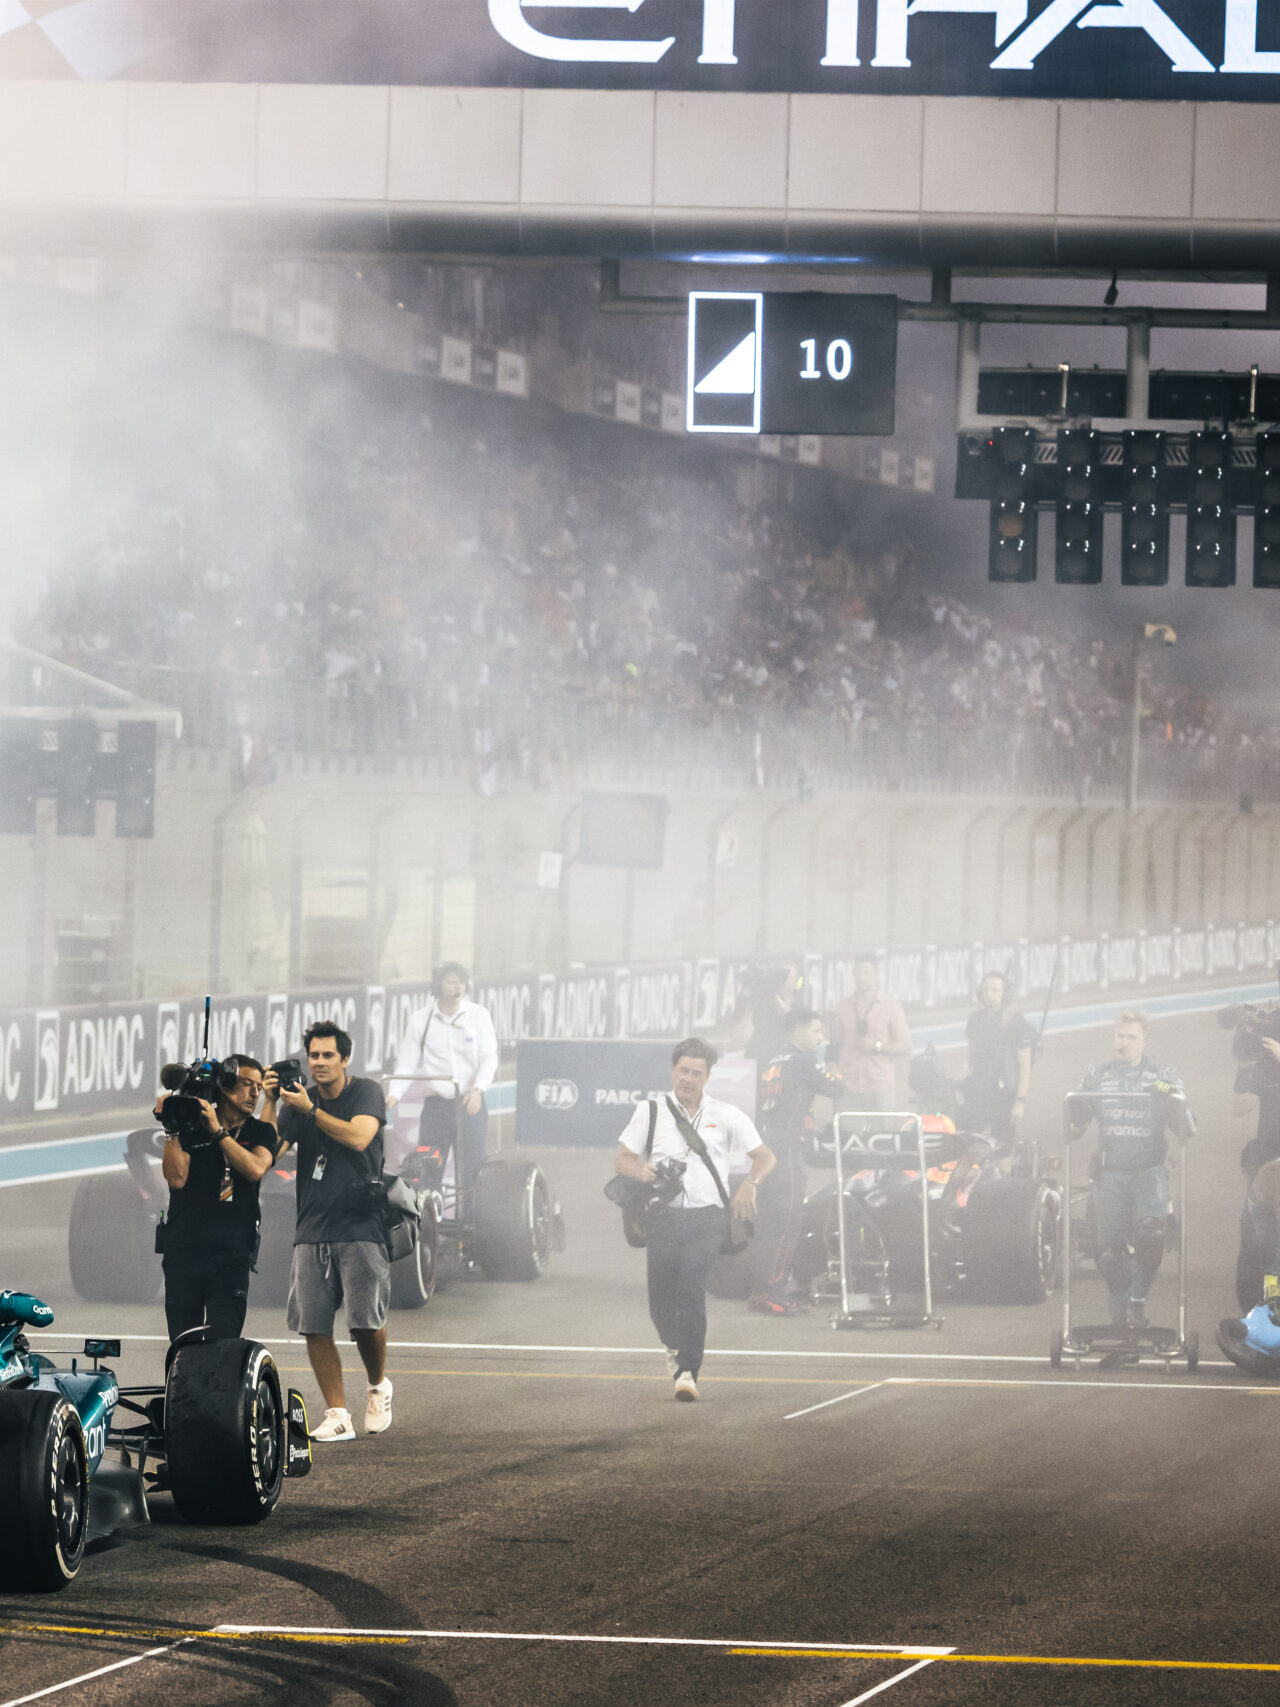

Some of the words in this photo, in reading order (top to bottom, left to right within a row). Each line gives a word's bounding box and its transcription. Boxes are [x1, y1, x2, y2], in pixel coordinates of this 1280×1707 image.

[799, 338, 852, 381] 10
[554, 977, 607, 1037] ADNOC
[63, 1014, 144, 1095] ADNOC
[595, 1089, 642, 1105] PARC
[50, 1418, 64, 1494] ZERO
[249, 1424, 263, 1493] ZERO
